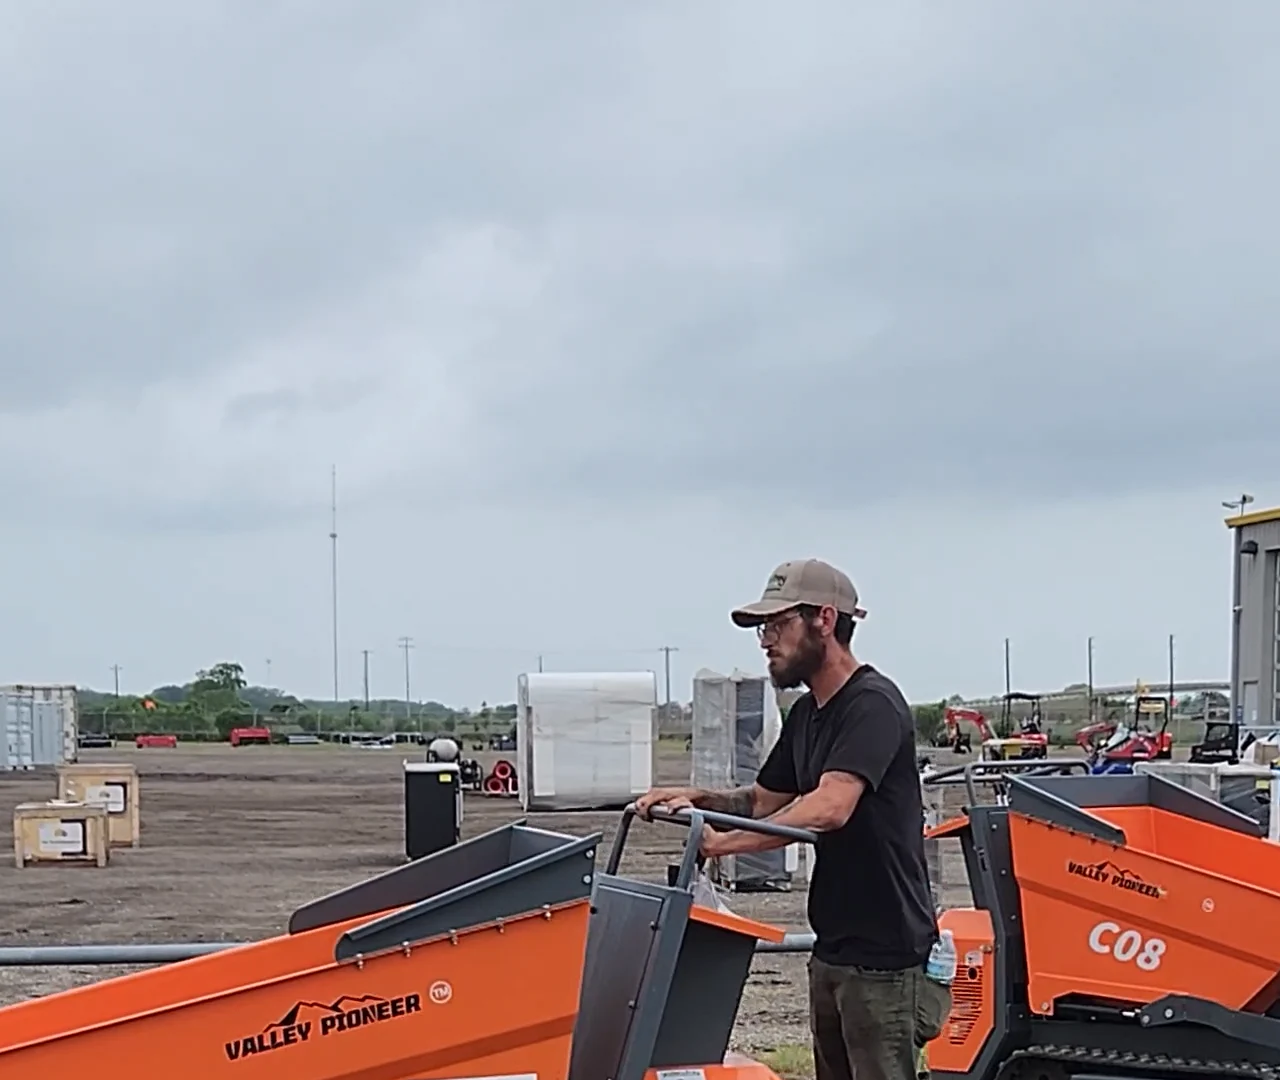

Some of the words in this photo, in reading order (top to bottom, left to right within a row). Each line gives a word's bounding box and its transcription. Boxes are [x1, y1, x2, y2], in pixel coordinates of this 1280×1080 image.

[1068, 861, 1109, 883] VALLEY
[1088, 921, 1166, 971] C08
[225, 1021, 312, 1060] VALLEY
[321, 994, 422, 1036] PIONEER
